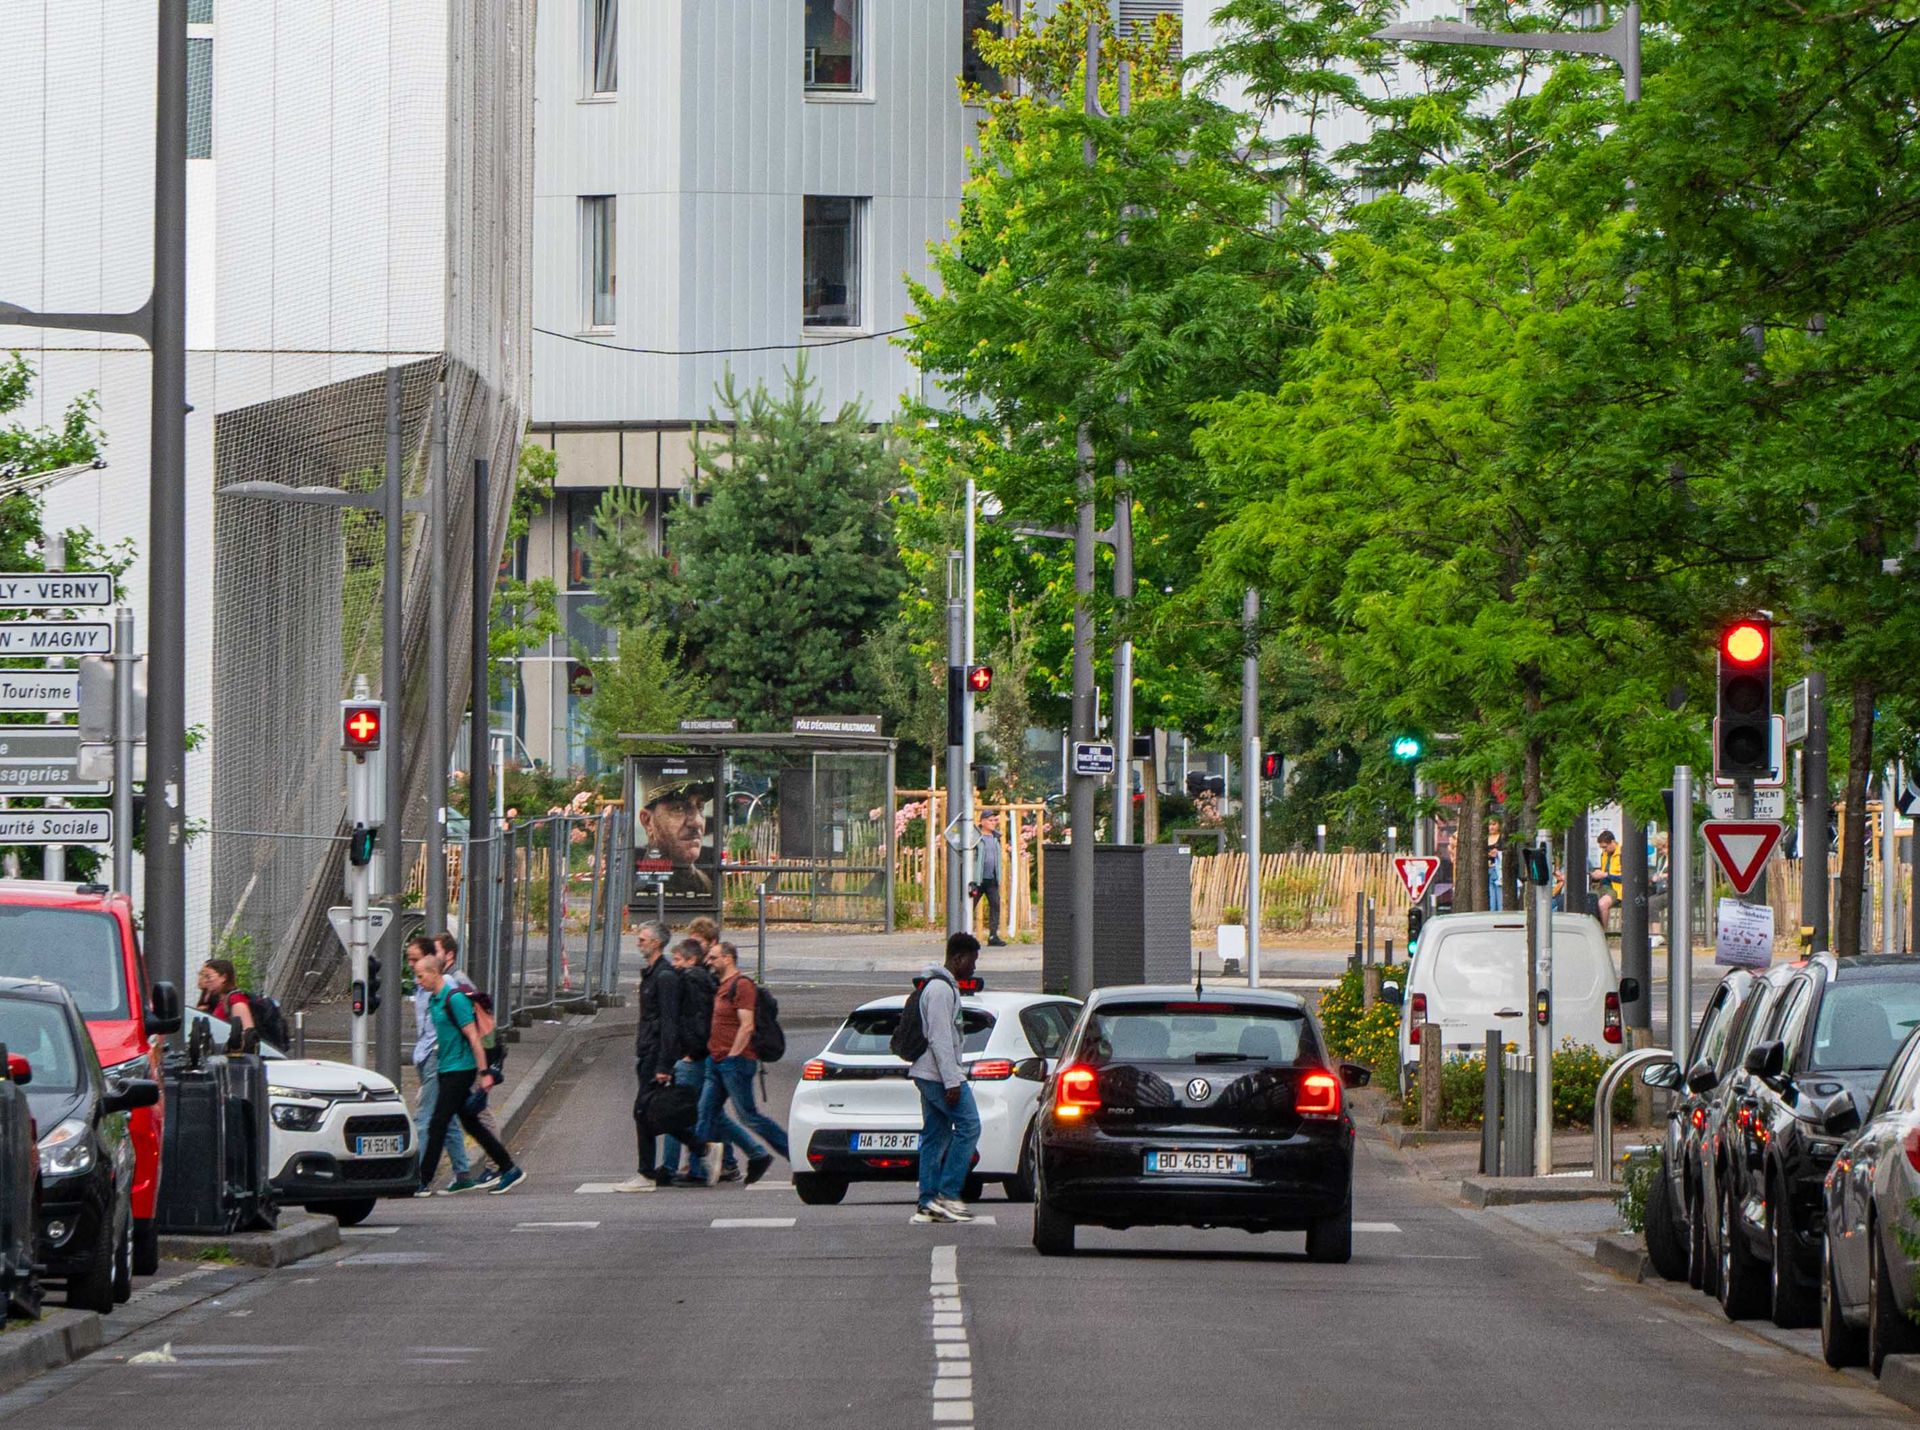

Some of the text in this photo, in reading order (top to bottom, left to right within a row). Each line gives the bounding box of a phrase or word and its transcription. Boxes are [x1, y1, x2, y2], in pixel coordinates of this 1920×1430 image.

[38, 583, 99, 598] VERNY
[30, 631, 98, 647] MAGNY
[2, 683, 71, 698] Tourisme
[0, 766, 70, 786] sageries
[42, 820, 99, 835] Sociale
[1107, 1107, 1135, 1115] POLO
